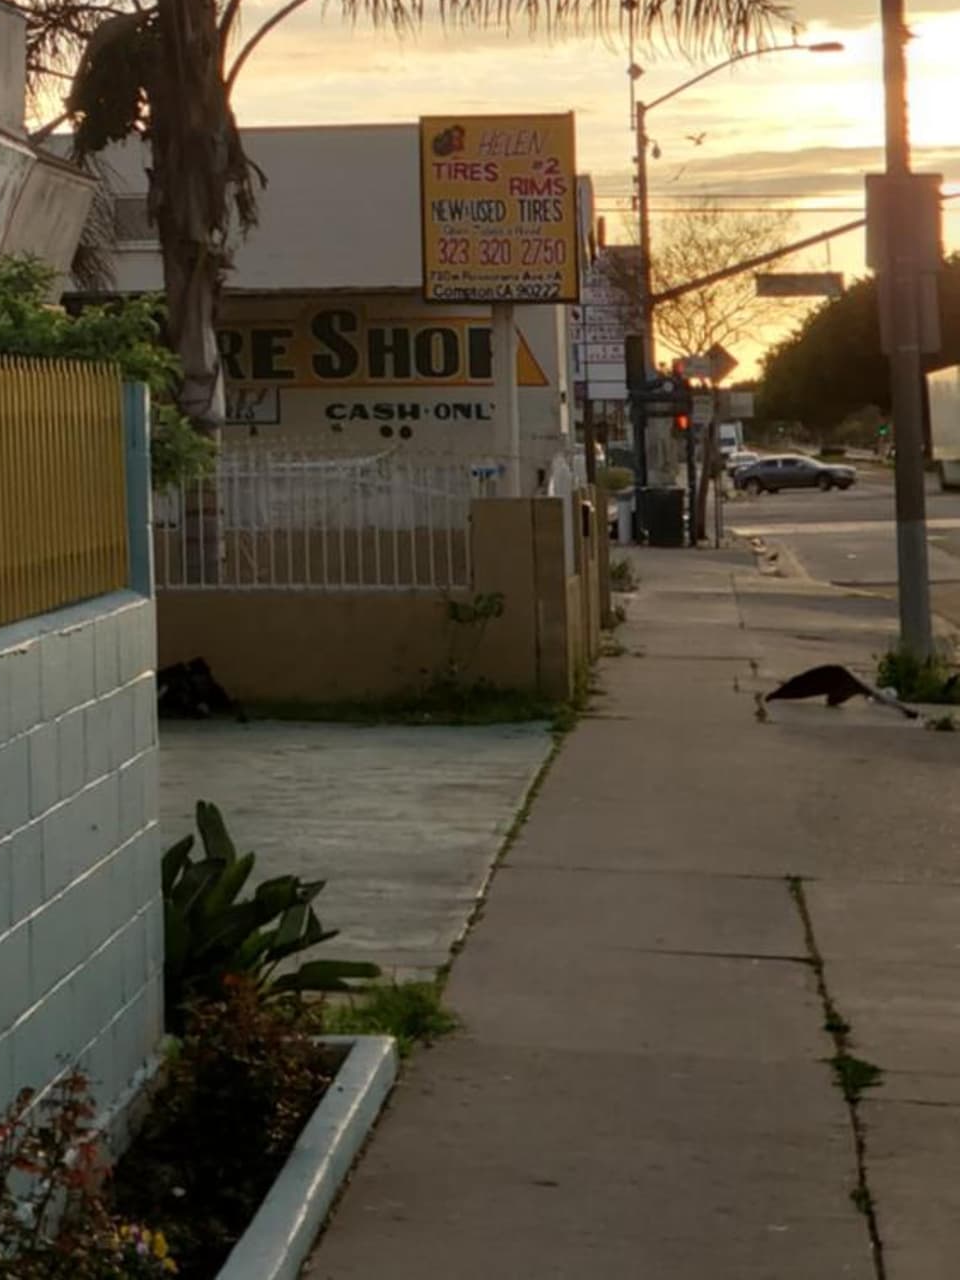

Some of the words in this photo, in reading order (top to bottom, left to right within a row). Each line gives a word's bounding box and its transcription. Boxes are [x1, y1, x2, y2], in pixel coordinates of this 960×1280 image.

[432, 162, 499, 182] TIRES
[509, 177, 567, 196] RIMS
[518, 199, 563, 222] TIRES
[438, 239, 470, 264] 323
[479, 239, 511, 265] 320
[521, 239, 566, 265] 2750
[433, 283, 493, 298] Compton
[434, 402, 495, 420] ONL
